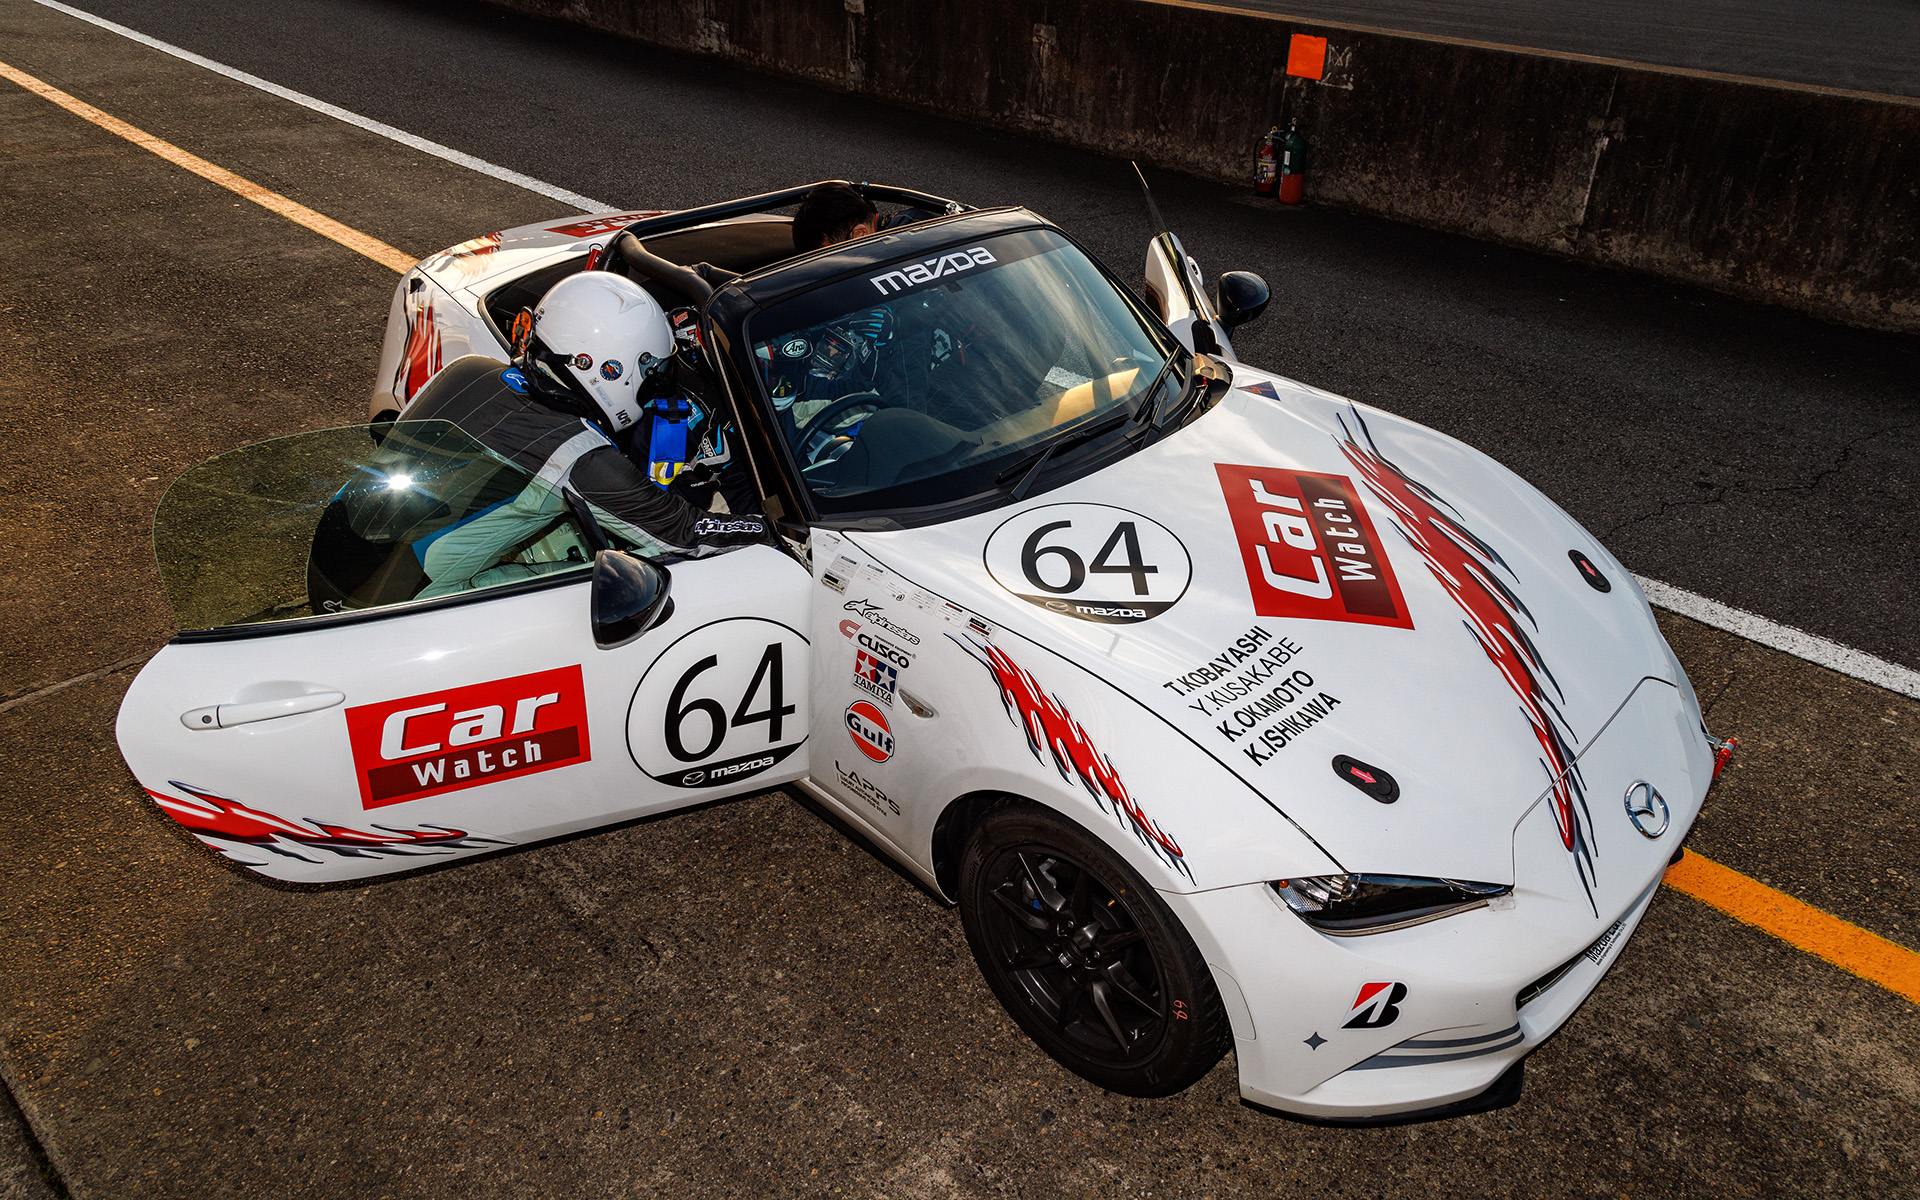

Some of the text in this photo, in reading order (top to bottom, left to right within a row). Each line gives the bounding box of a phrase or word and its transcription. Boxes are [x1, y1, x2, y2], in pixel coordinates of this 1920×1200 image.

[870, 246, 997, 295] mazda
[1021, 520, 1159, 596] 64
[1248, 478, 1333, 600] Car
[1313, 497, 1377, 581] Watch
[865, 611, 921, 646] alpinestars
[1075, 605, 1147, 619] mazda
[858, 633, 909, 669] CUSCO
[1163, 625, 1273, 697] T.KOBAYASHI
[1188, 636, 1304, 717] Y.KUSAKABE
[664, 641, 796, 763] 64
[853, 673, 893, 704] TAMIYA
[1216, 670, 1314, 743] K.OKAMOTO
[380, 691, 561, 761] Car
[847, 712, 894, 753] Gulf
[1242, 691, 1342, 767] K.ISHIKAWA
[411, 740, 542, 787] Watch
[710, 756, 775, 780] mazda
[835, 760, 900, 816] LAPPS
